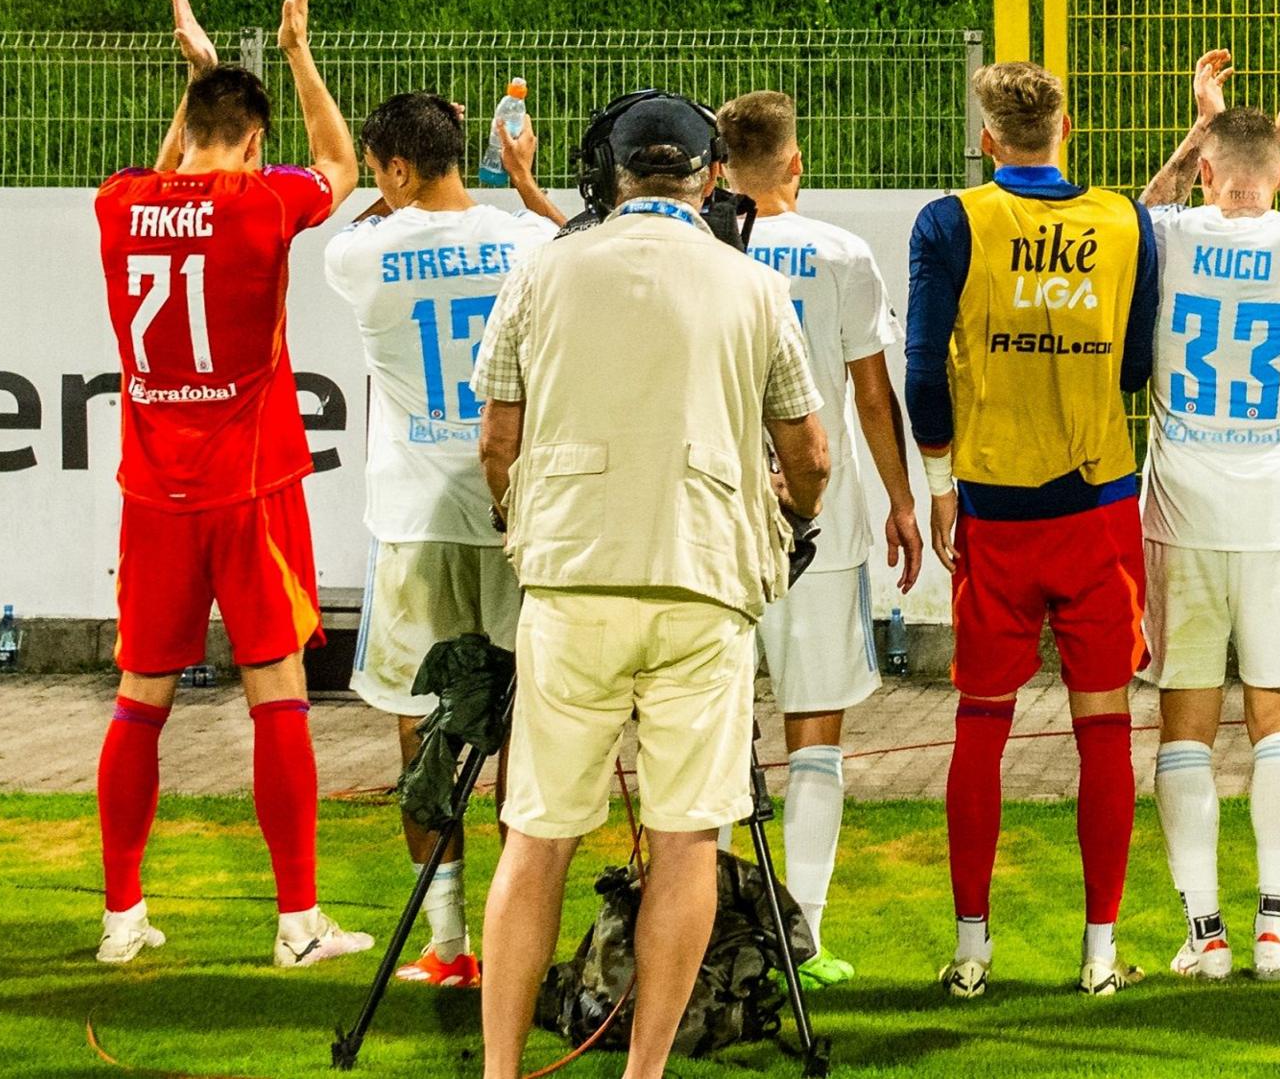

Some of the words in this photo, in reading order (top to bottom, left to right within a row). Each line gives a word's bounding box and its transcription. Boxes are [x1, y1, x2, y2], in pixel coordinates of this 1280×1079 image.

[129, 200, 214, 238] TAKÁČ
[1009, 221, 1098, 274] niké
[1013, 275, 1099, 310] LIGA
[126, 253, 214, 373] 71
[148, 382, 238, 403] grafobal
